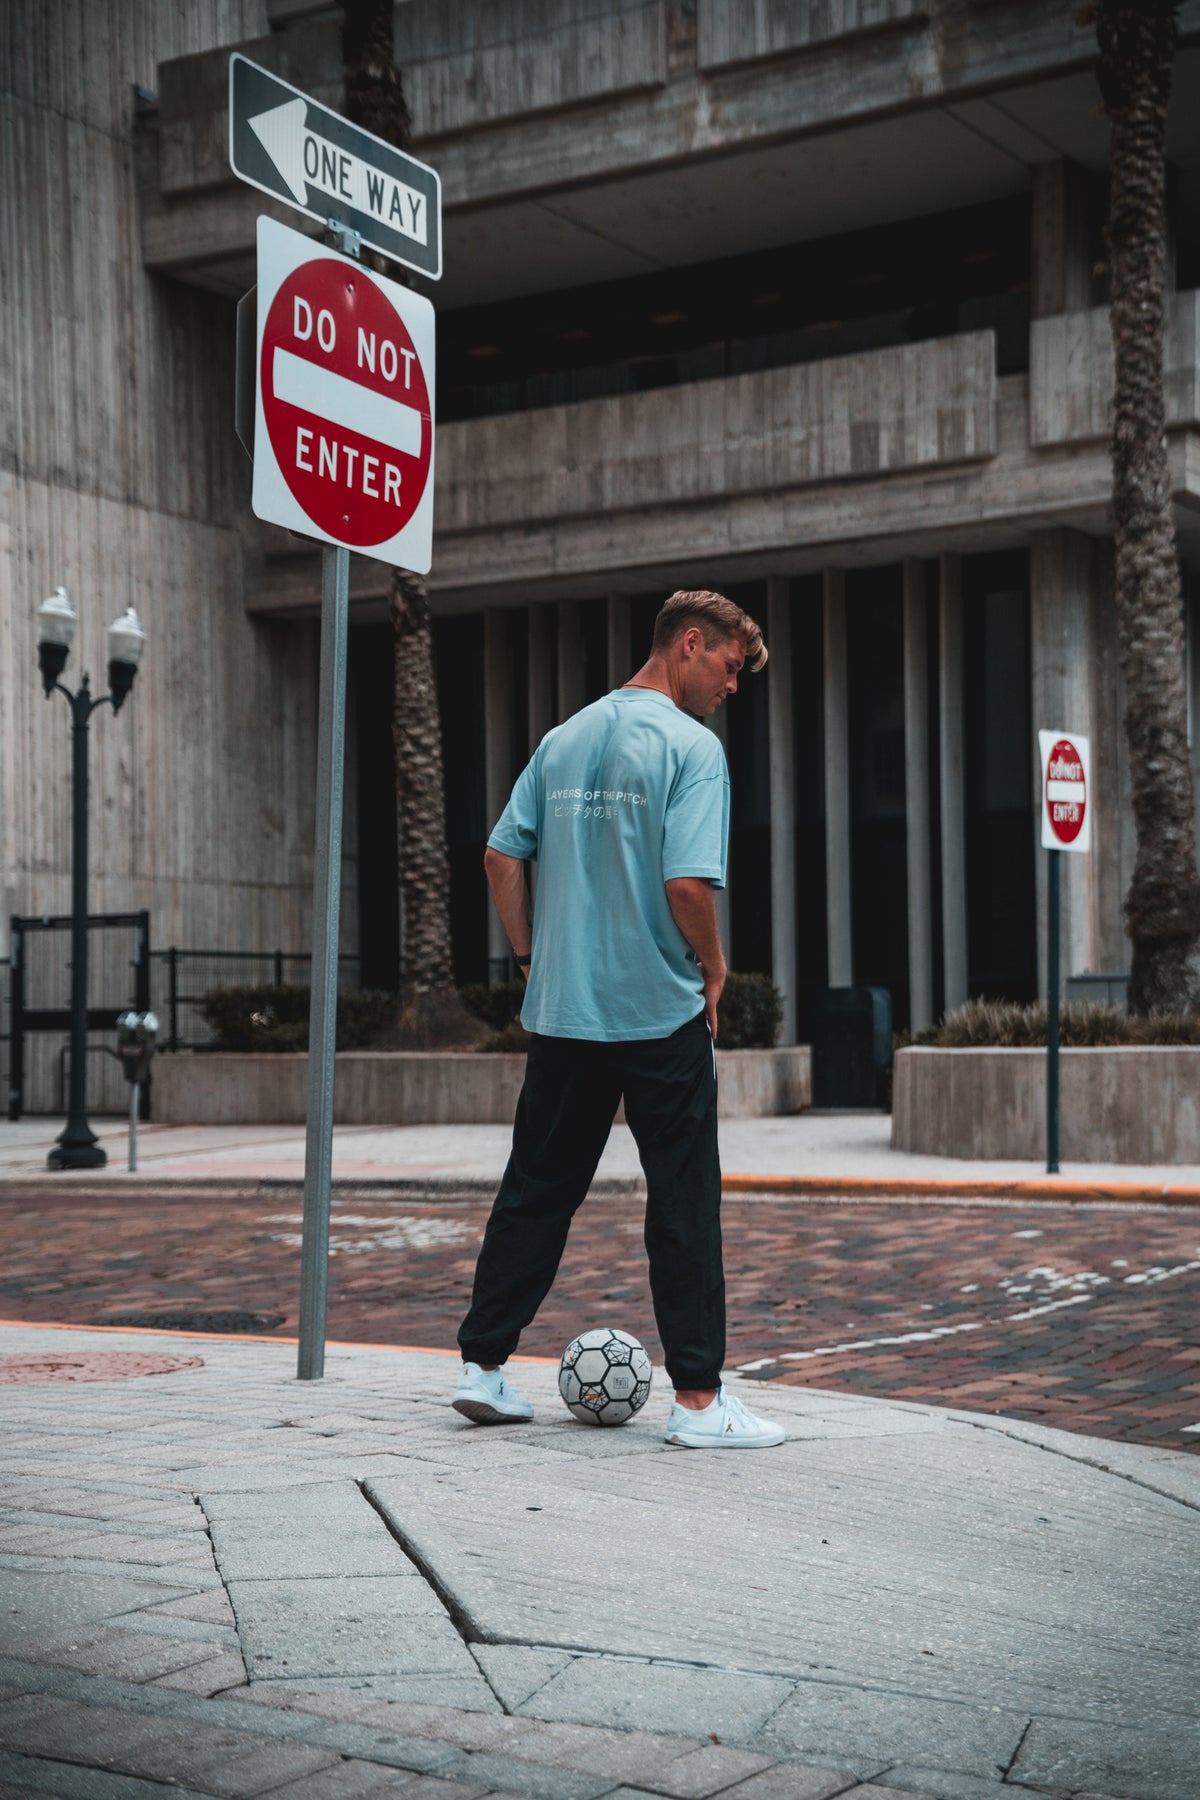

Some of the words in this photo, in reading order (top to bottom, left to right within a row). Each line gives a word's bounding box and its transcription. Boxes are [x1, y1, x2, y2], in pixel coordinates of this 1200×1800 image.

[303, 135, 353, 200] ONE
[366, 169, 421, 234] WAY
[293, 295, 336, 353] DO
[357, 326, 416, 390] NOT
[295, 425, 402, 507] ENTER
[1064, 762, 1081, 780] NOT
[616, 791, 647, 806] PITCH
[1053, 803, 1079, 822] ENTER
